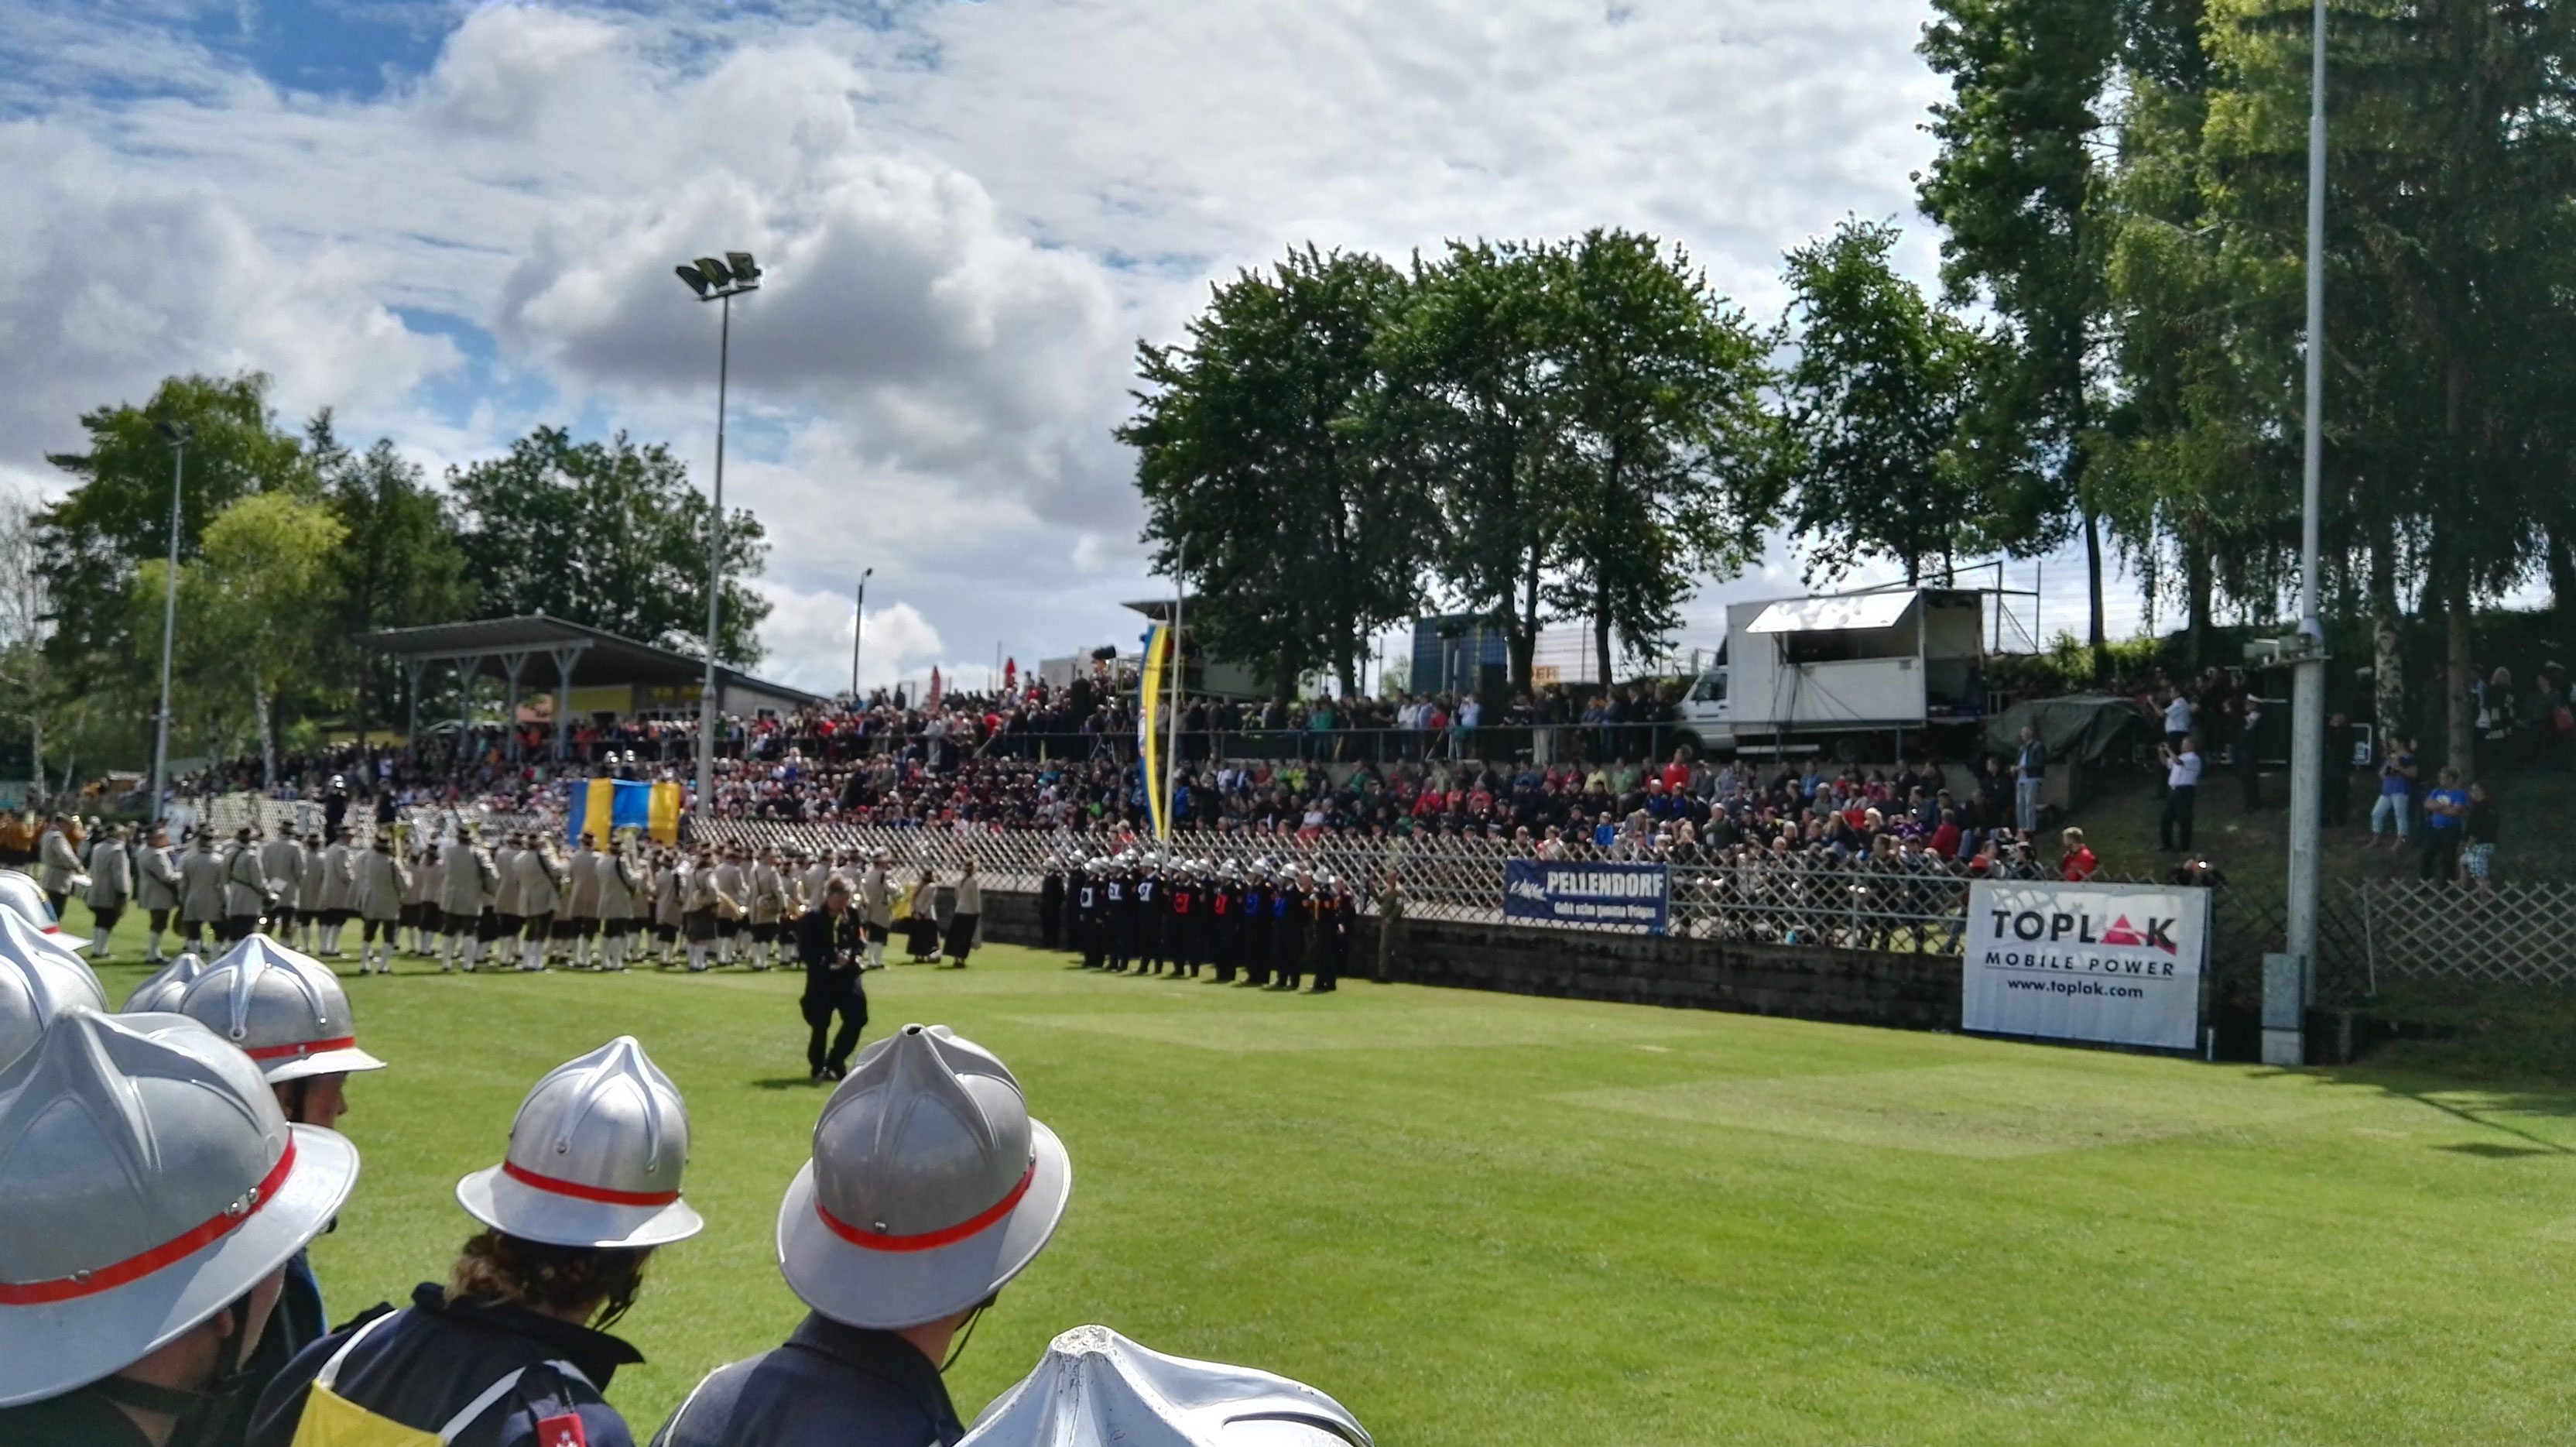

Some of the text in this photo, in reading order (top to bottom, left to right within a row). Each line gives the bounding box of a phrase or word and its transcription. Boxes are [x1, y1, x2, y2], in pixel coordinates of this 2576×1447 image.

[1547, 871, 1663, 897] PELLENDORF
[1991, 910, 2177, 949] TOPLAK
[1985, 952, 2174, 976] MOBILE POWER
[2007, 978, 2143, 999] www.toplak.com
